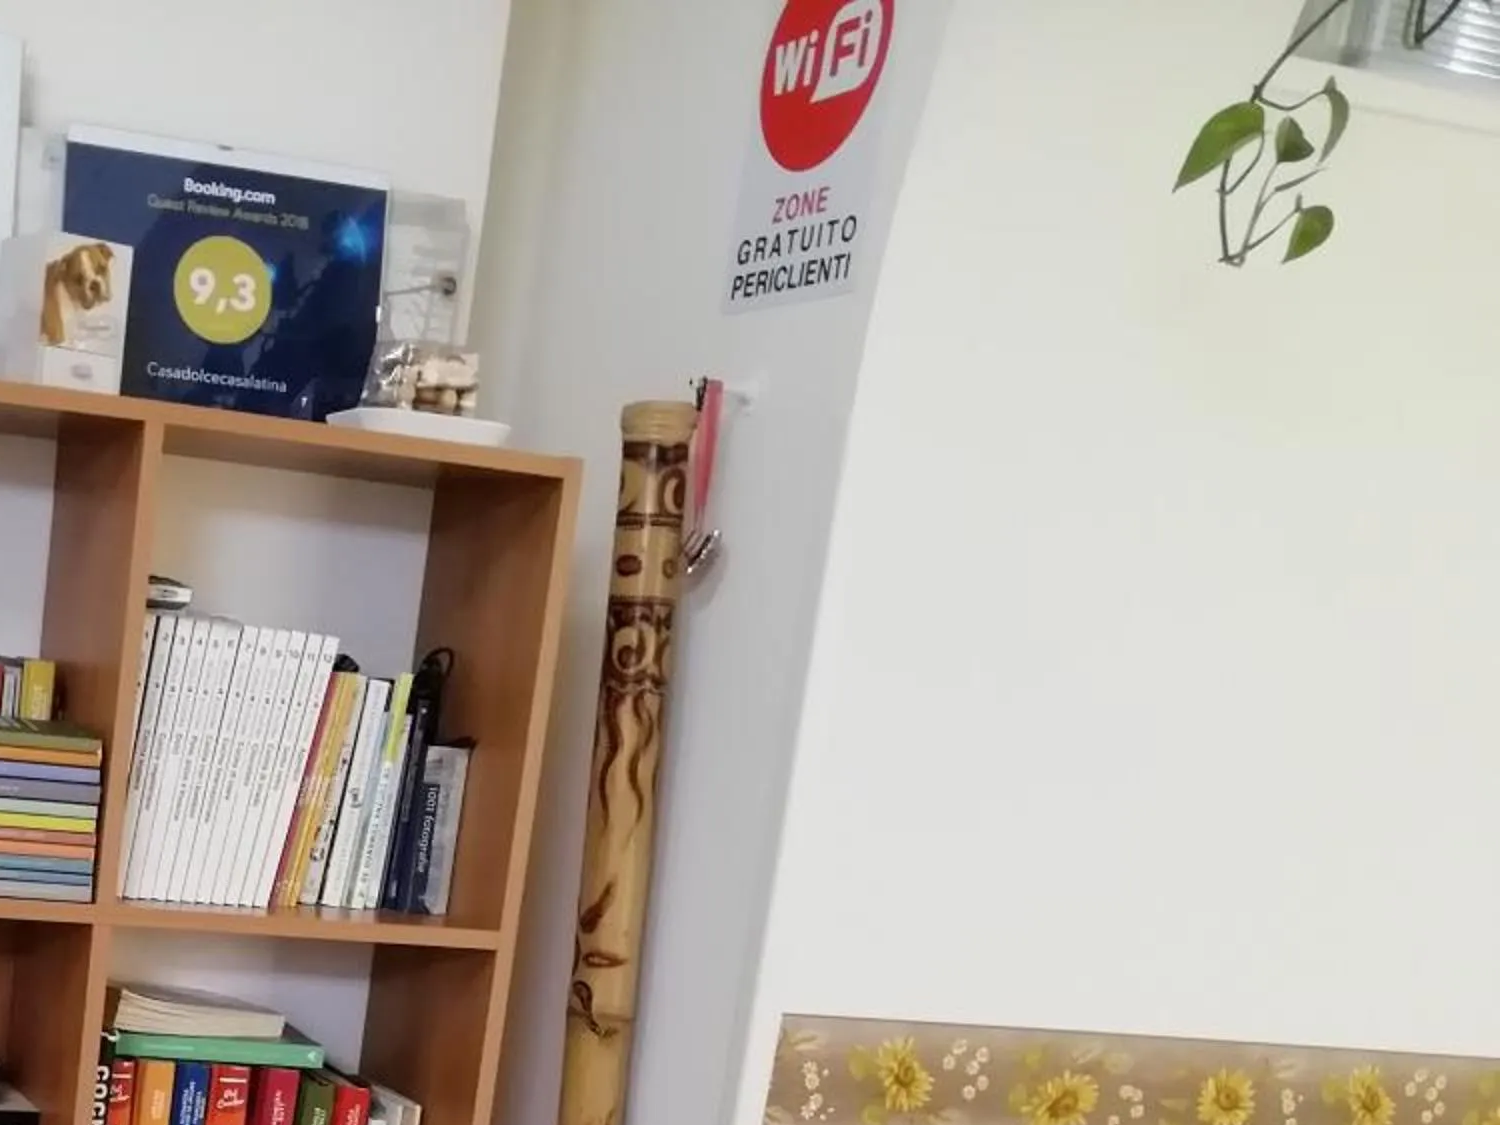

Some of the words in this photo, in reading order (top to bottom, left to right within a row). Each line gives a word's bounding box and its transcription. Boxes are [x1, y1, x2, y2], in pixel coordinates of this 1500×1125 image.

[184, 177, 276, 205] Booking.com
[772, 186, 830, 224] ZONE
[737, 215, 857, 265] GRATUITO
[189, 267, 256, 314] 9,3
[147, 362, 287, 393] Casadolcecasalatina
[424, 786, 439, 812] 1001
[416, 814, 435, 874] fotografie
